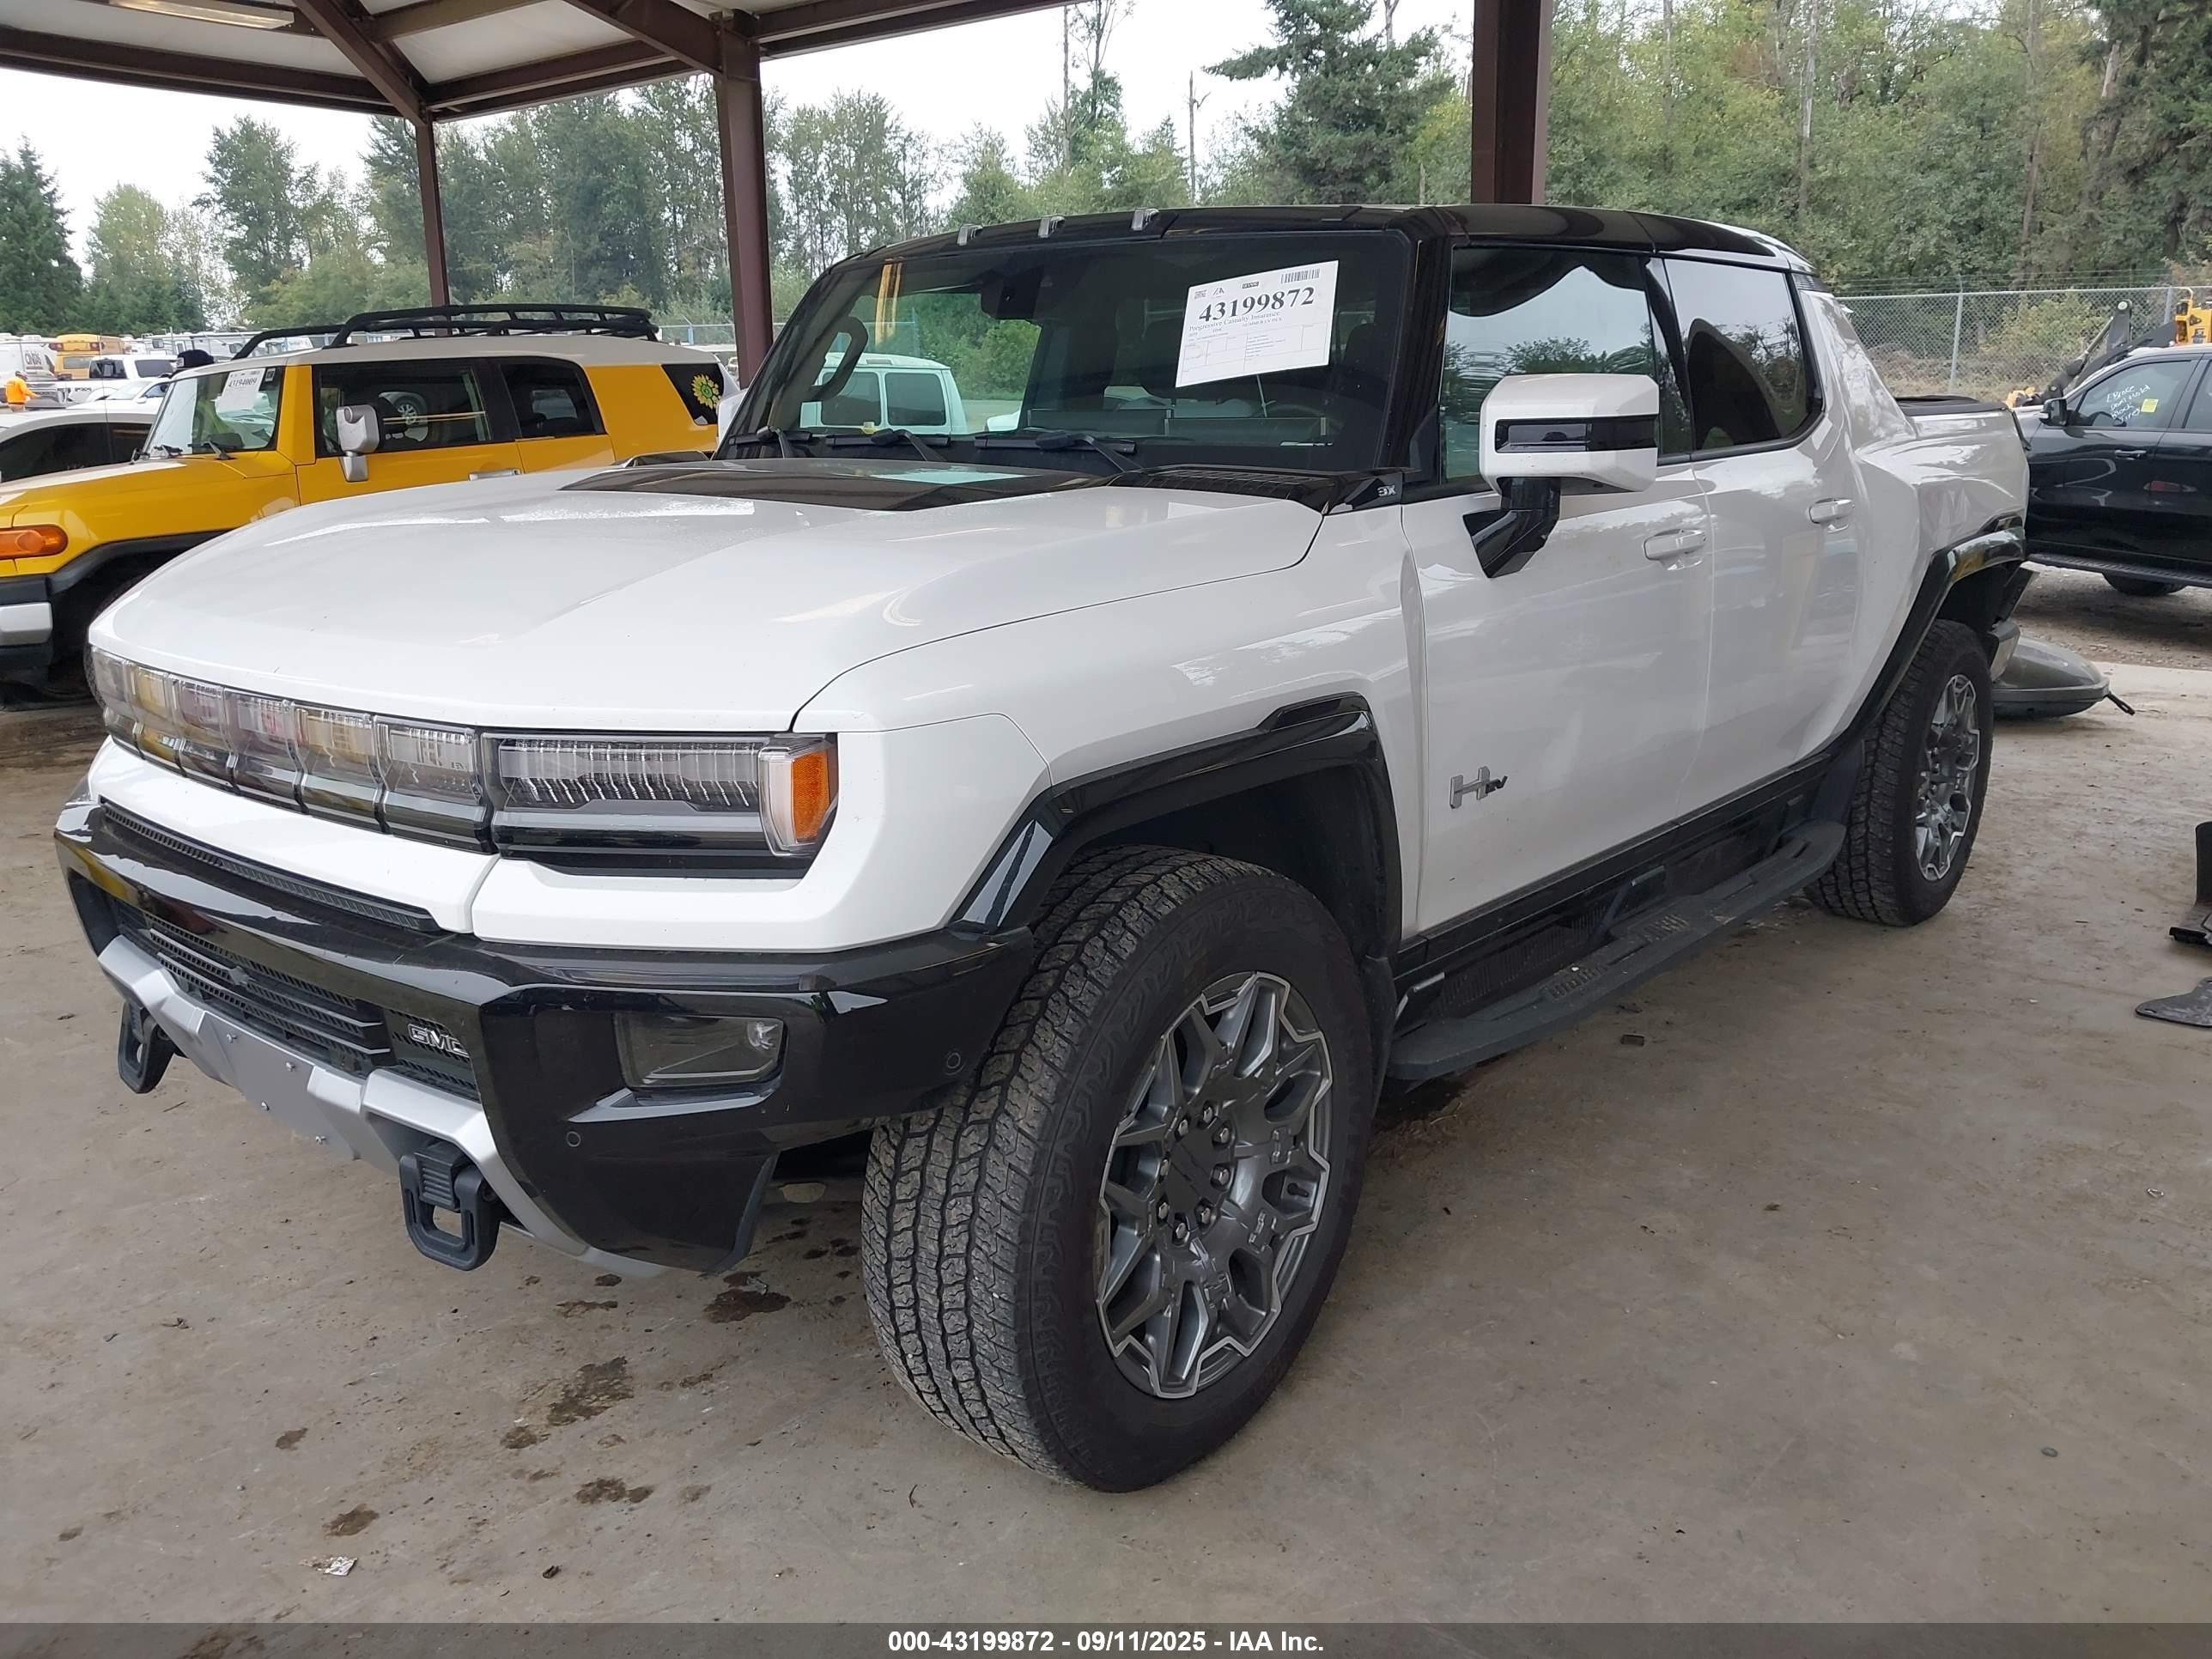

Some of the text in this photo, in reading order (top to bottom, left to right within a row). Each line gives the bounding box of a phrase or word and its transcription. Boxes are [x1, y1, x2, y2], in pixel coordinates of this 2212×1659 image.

[1199, 287, 1315, 322] 43199872
[1376, 484, 1397, 497] 3X
[407, 1024, 471, 1059] GMC
